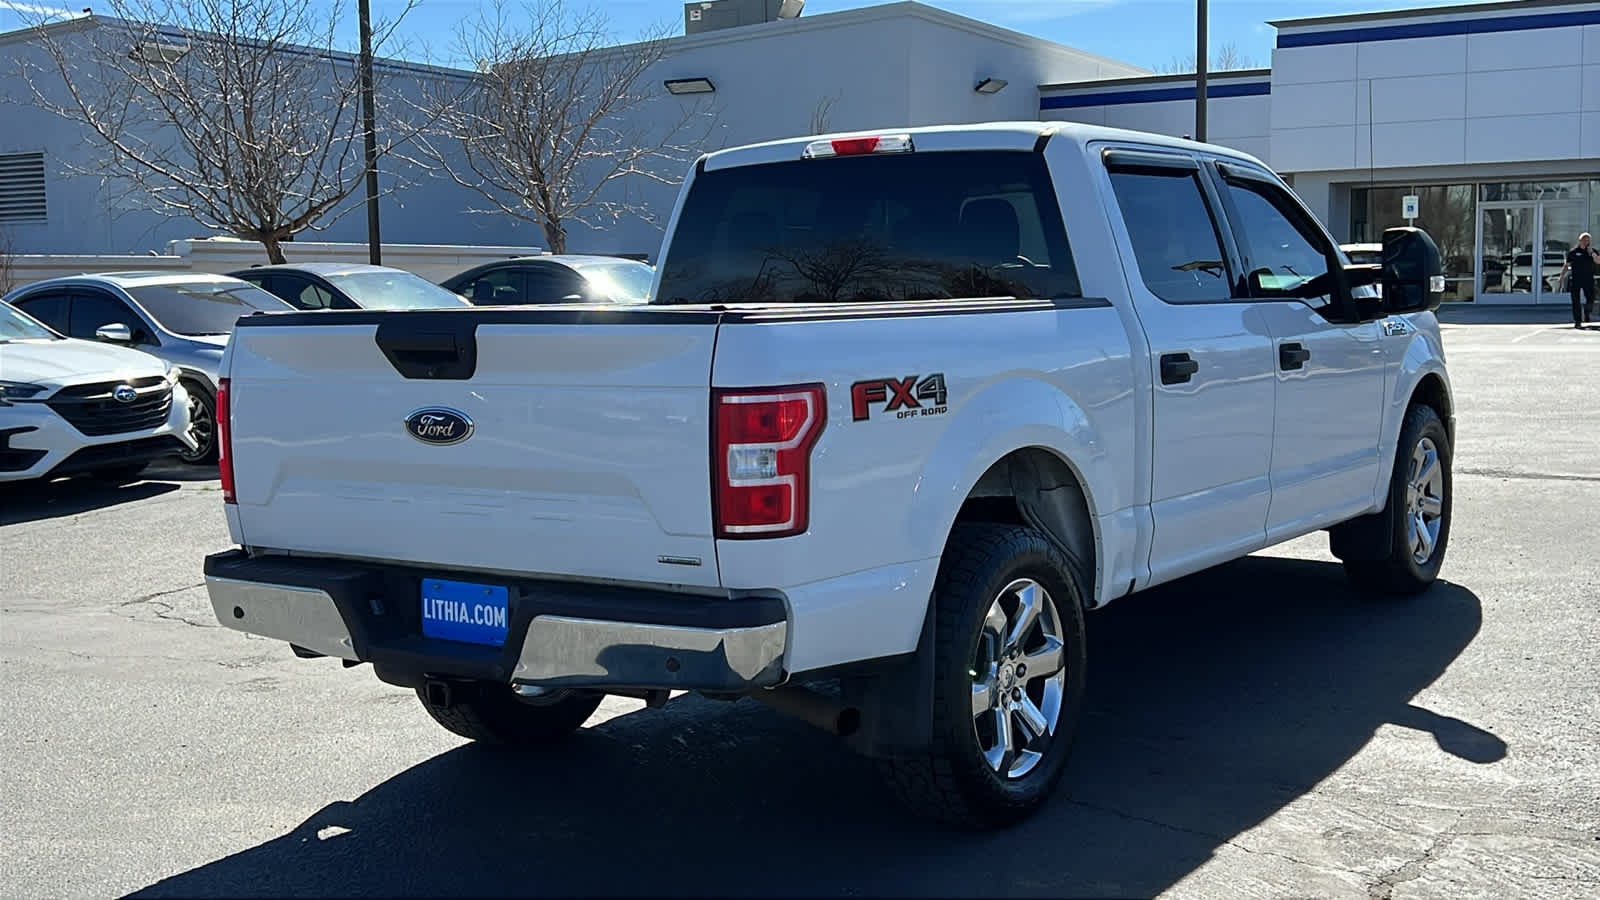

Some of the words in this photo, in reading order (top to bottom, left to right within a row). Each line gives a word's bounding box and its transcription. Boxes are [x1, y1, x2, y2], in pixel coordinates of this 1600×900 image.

[851, 373, 947, 422] FX4
[418, 414, 455, 437] Ford
[897, 409, 918, 419] OFF
[921, 406, 947, 417] ROAD
[424, 598, 506, 629] LITHIA.COM
